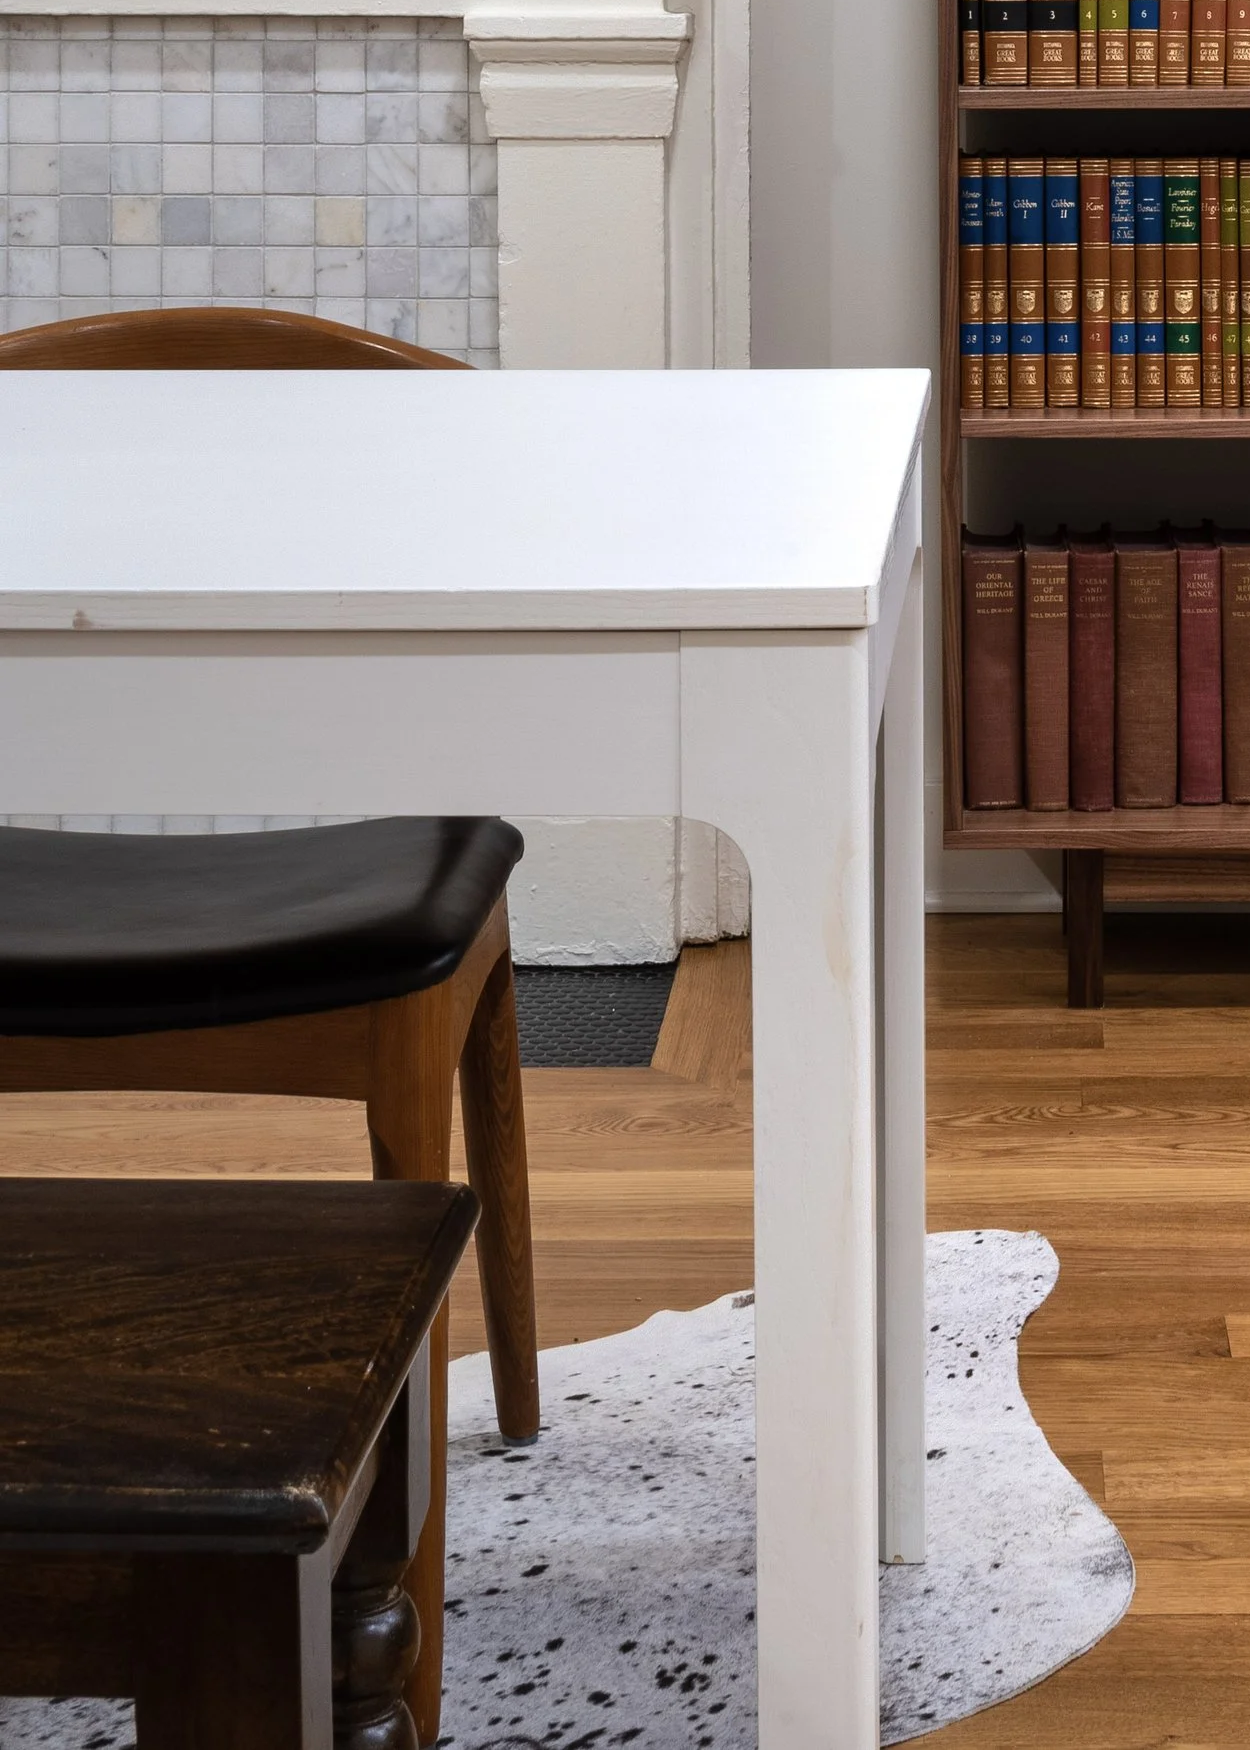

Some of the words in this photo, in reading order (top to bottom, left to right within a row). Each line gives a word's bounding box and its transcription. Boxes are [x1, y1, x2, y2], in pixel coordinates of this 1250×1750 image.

[1002, 11, 1008, 21] 2
[1050, 10, 1056, 20] 3
[1111, 10, 1117, 19] 5
[1206, 10, 1212, 20] 8
[1013, 199, 1037, 209] Gibbon
[1085, 203, 1104, 212] Kant
[1170, 219, 1196, 230] Faraday
[1058, 334, 1069, 343] 41
[1178, 335, 1190, 344] 45
[1031, 577, 1047, 585] THE
[1048, 577, 1066, 585] LIFE
[1188, 590, 1213, 598] SANCE
